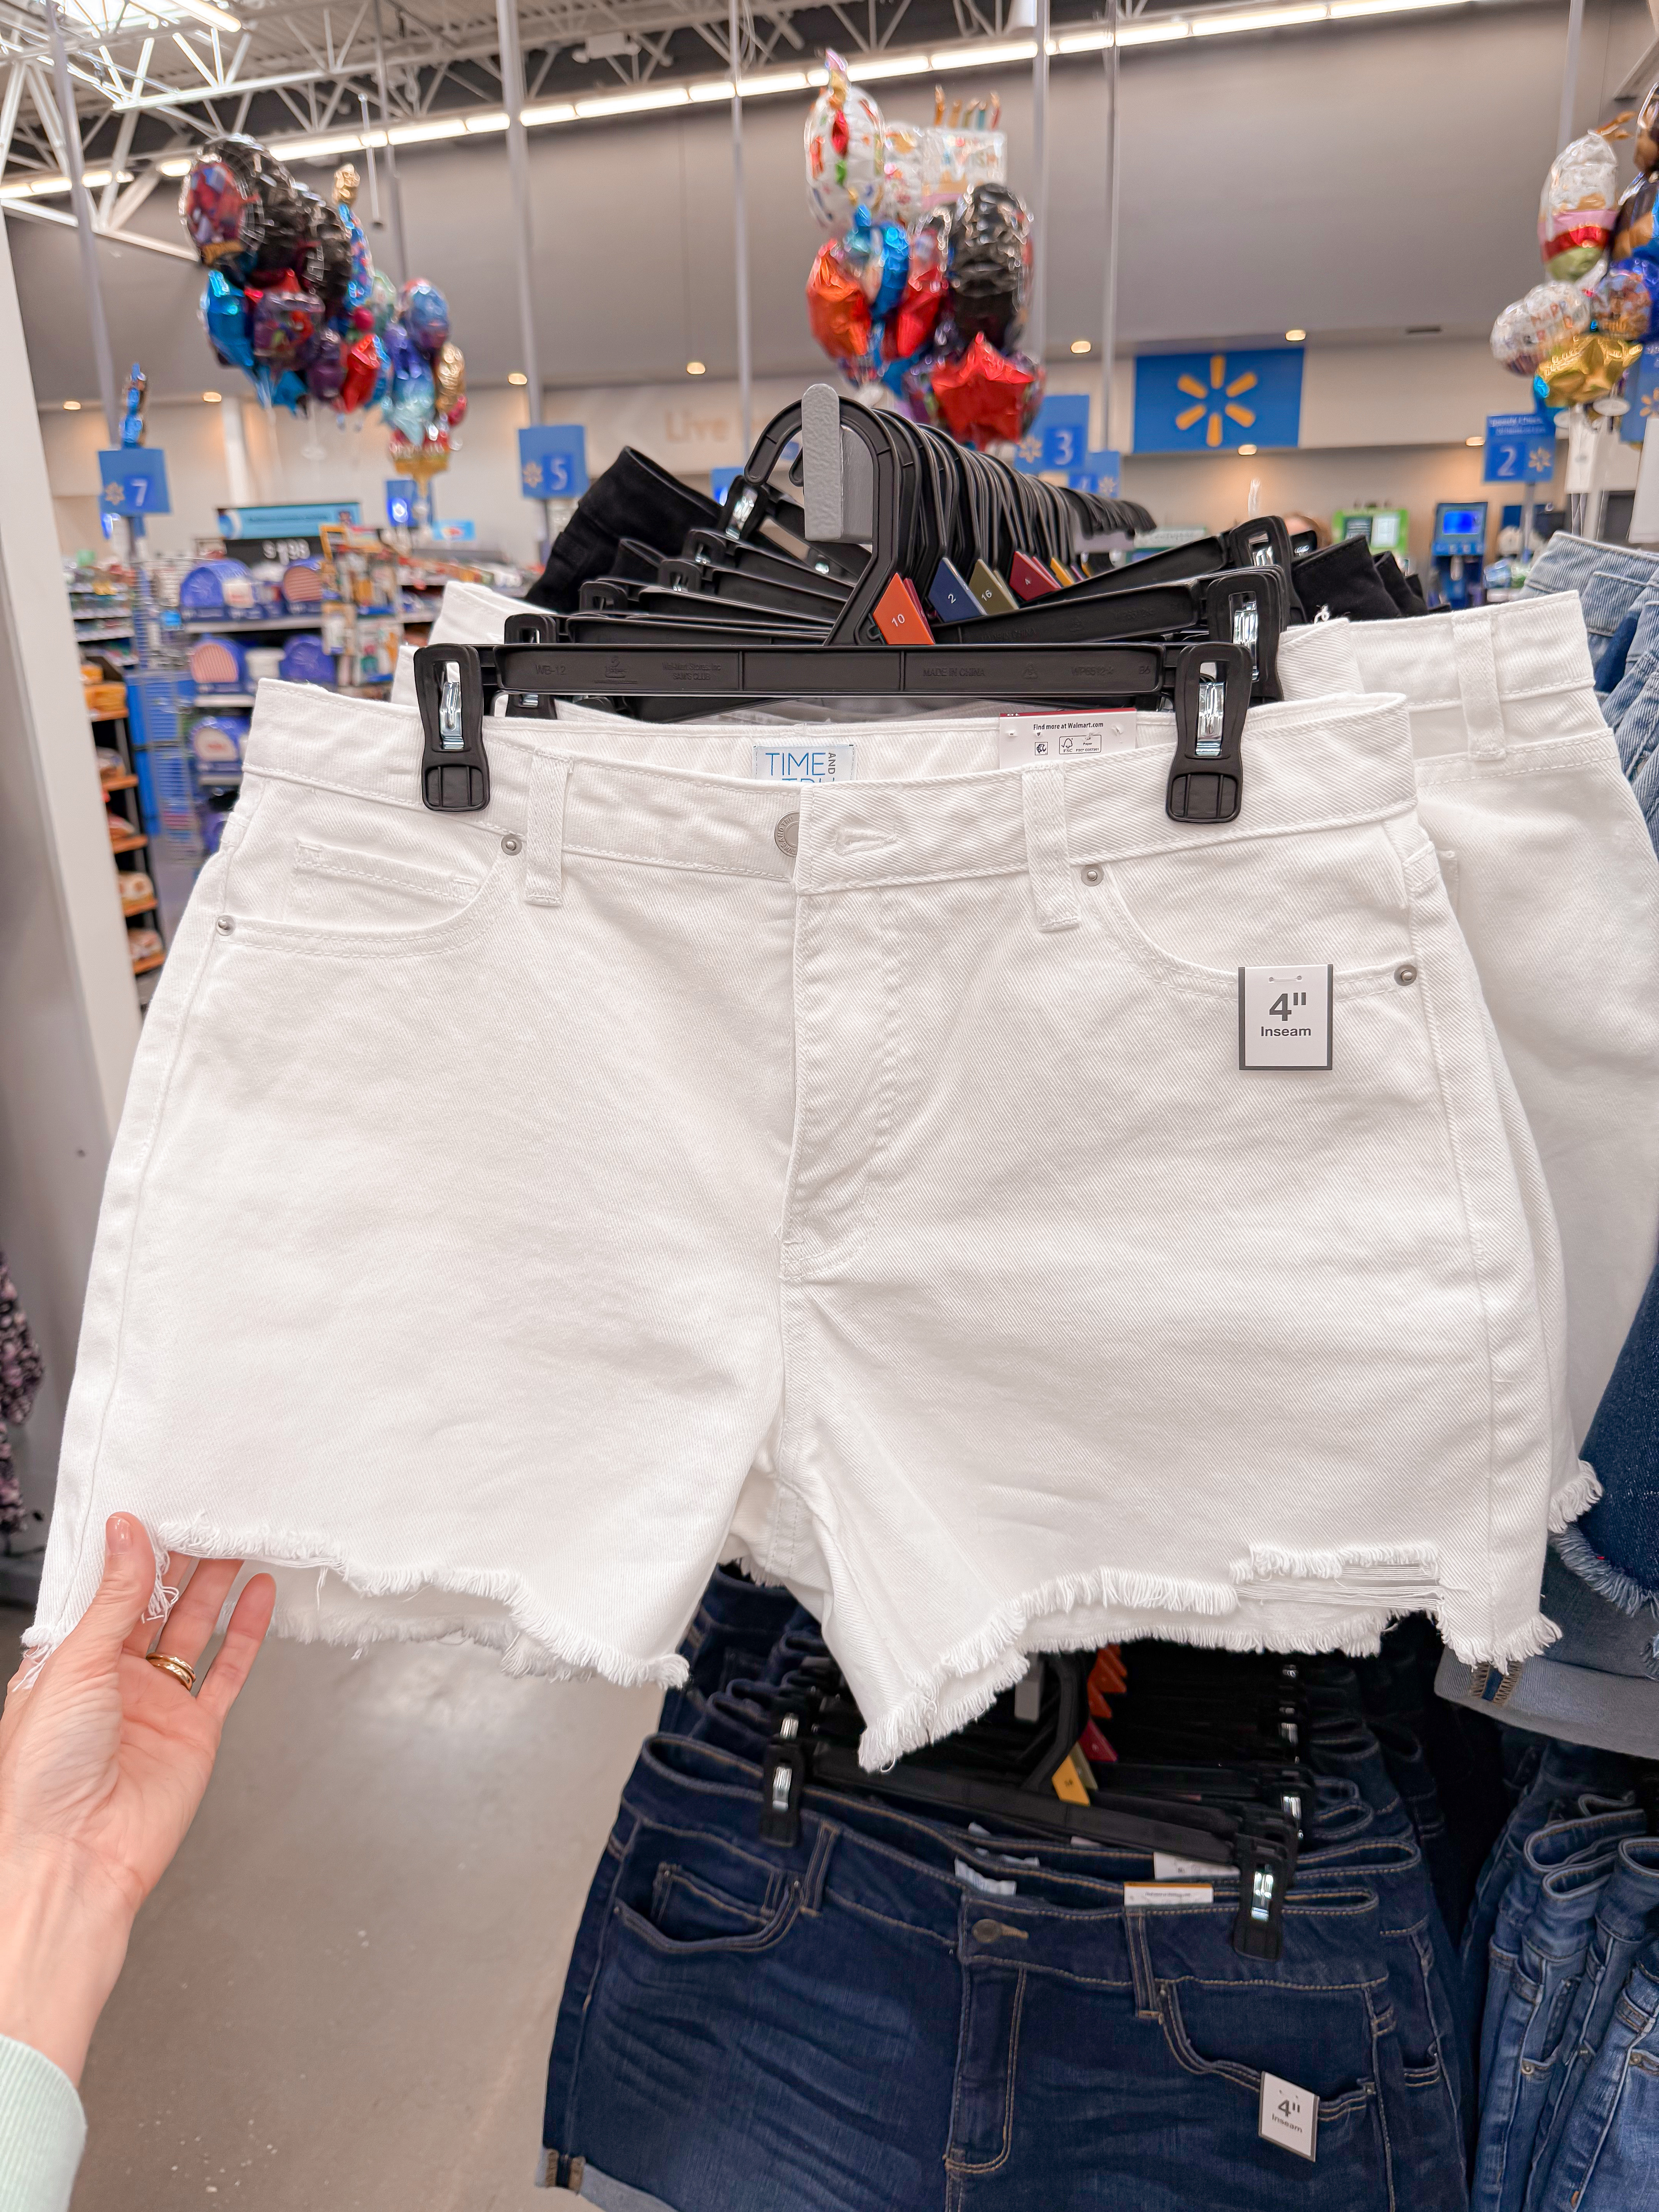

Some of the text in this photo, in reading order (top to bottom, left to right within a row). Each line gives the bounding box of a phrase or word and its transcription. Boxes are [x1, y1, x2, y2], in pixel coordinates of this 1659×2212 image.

[1054, 429, 1074, 465] 3
[1497, 447, 1517, 477] 2
[551, 457, 568, 491] 5
[131, 479, 148, 507] 7
[948, 593, 956, 604] 2
[981, 590, 993, 601] 16
[891, 614, 905, 627] 10
[923, 668, 986, 677] MADE IN CHINA
[765, 752, 826, 776] TIME
[828, 752, 836, 775] AND
[777, 827, 785, 842] AND
[781, 815, 793, 827] TRU
[1269, 992, 1306, 1022] 4"
[1261, 1026, 1311, 1037] Inseam
[1278, 2099, 1300, 2118] 4"
[1271, 2113, 1303, 2133] Inseam
